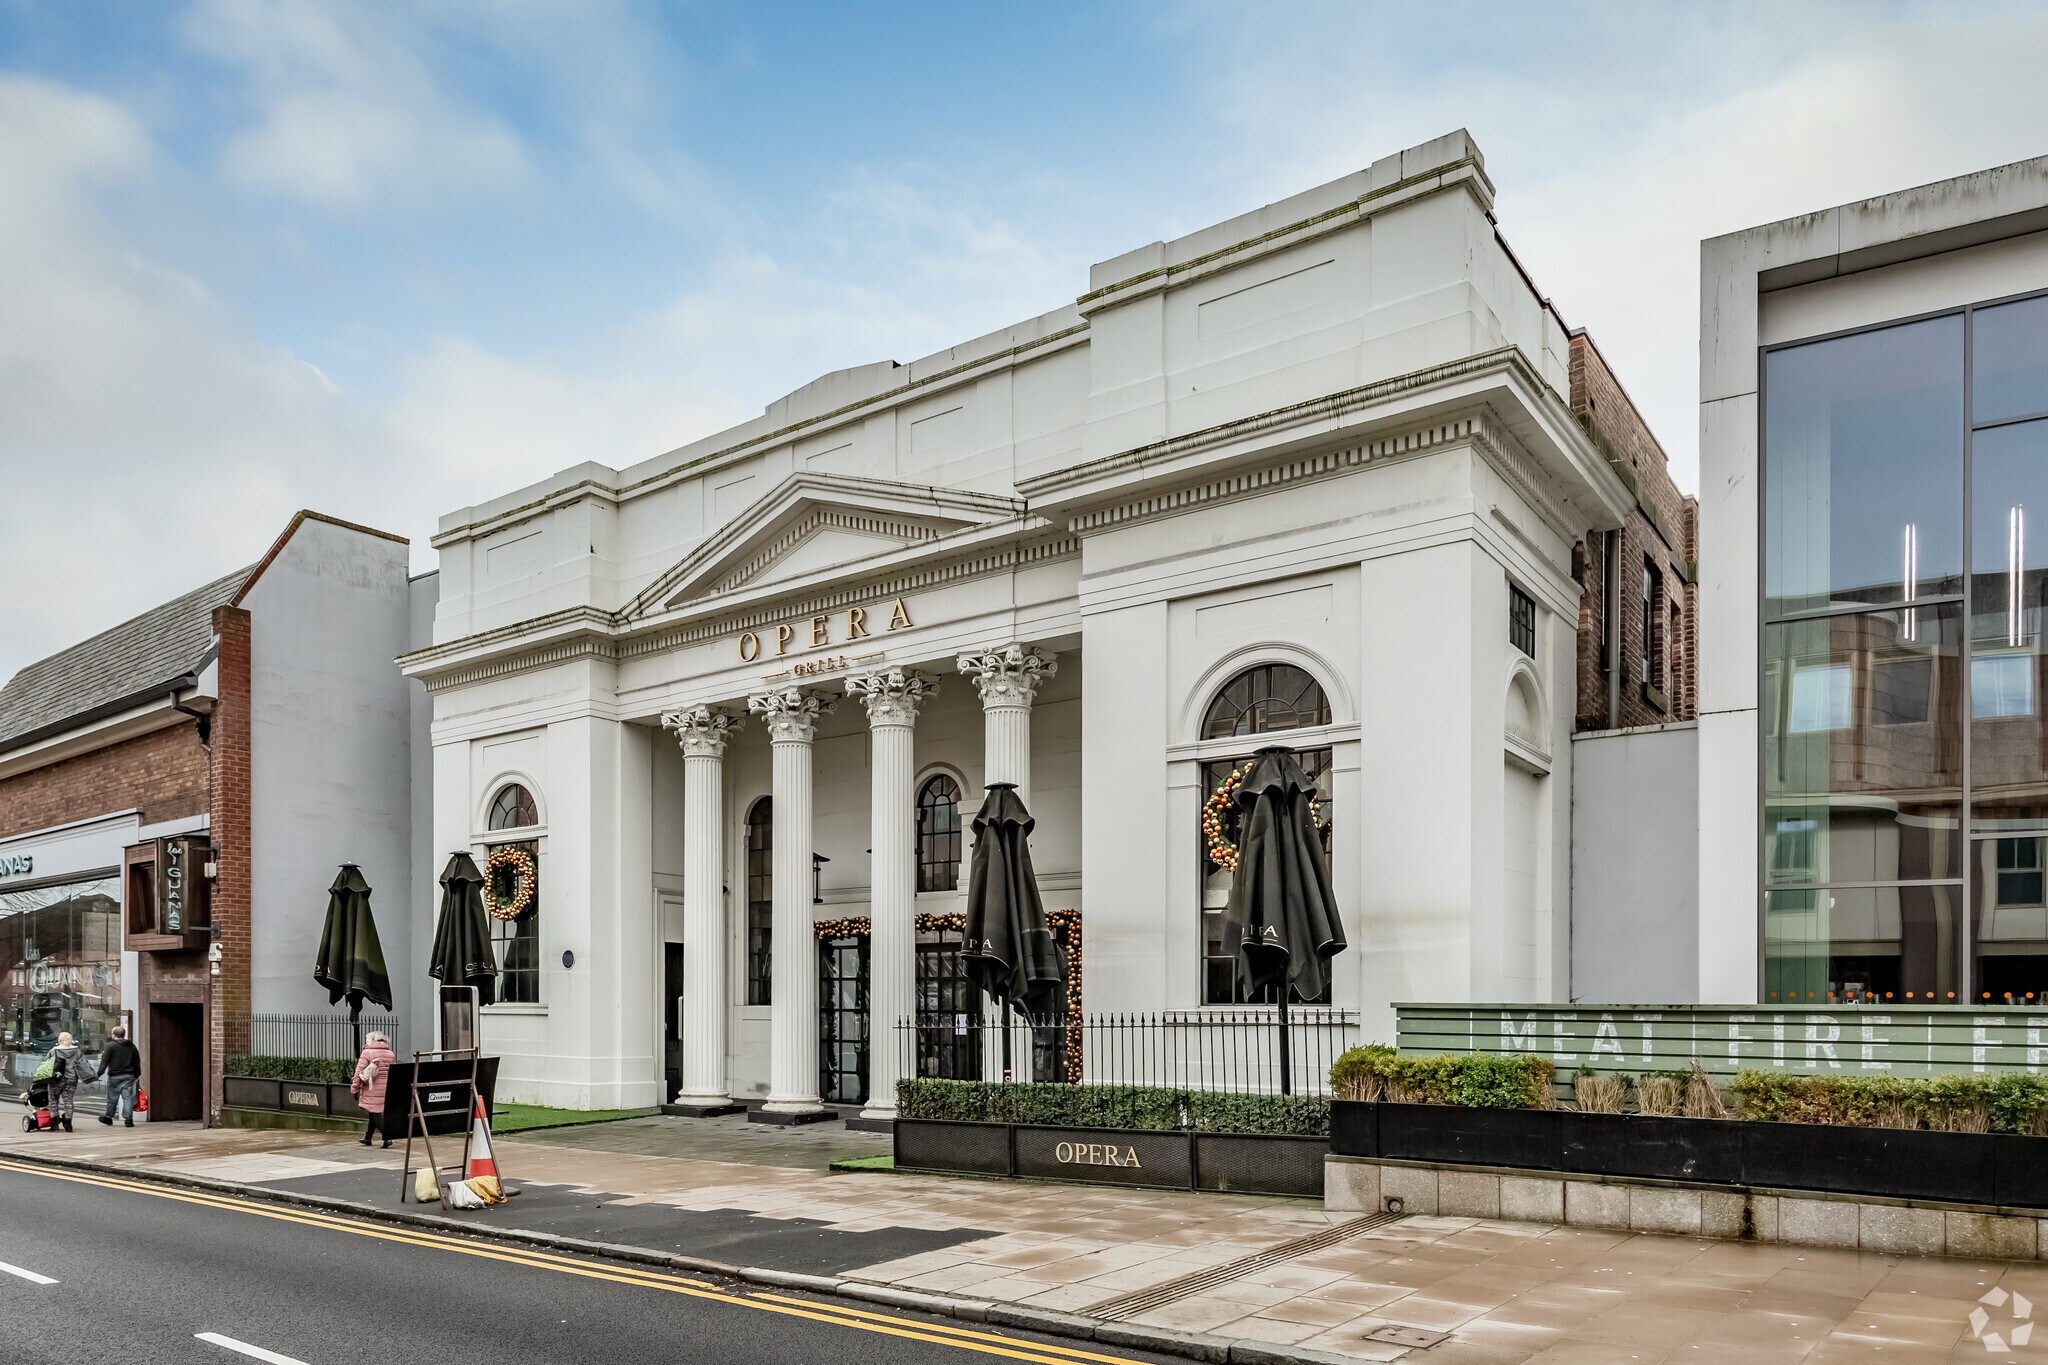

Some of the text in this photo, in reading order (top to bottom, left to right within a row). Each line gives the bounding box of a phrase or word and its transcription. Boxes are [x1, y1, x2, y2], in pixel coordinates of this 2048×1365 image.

[738, 597, 913, 662] OPERA
[793, 655, 848, 676] GRILL
[1501, 1011, 1663, 1064] MEAT
[1728, 1014, 1892, 1070] FIRE
[288, 1090, 319, 1107] OPERA
[1055, 1141, 1142, 1168] OPERA
